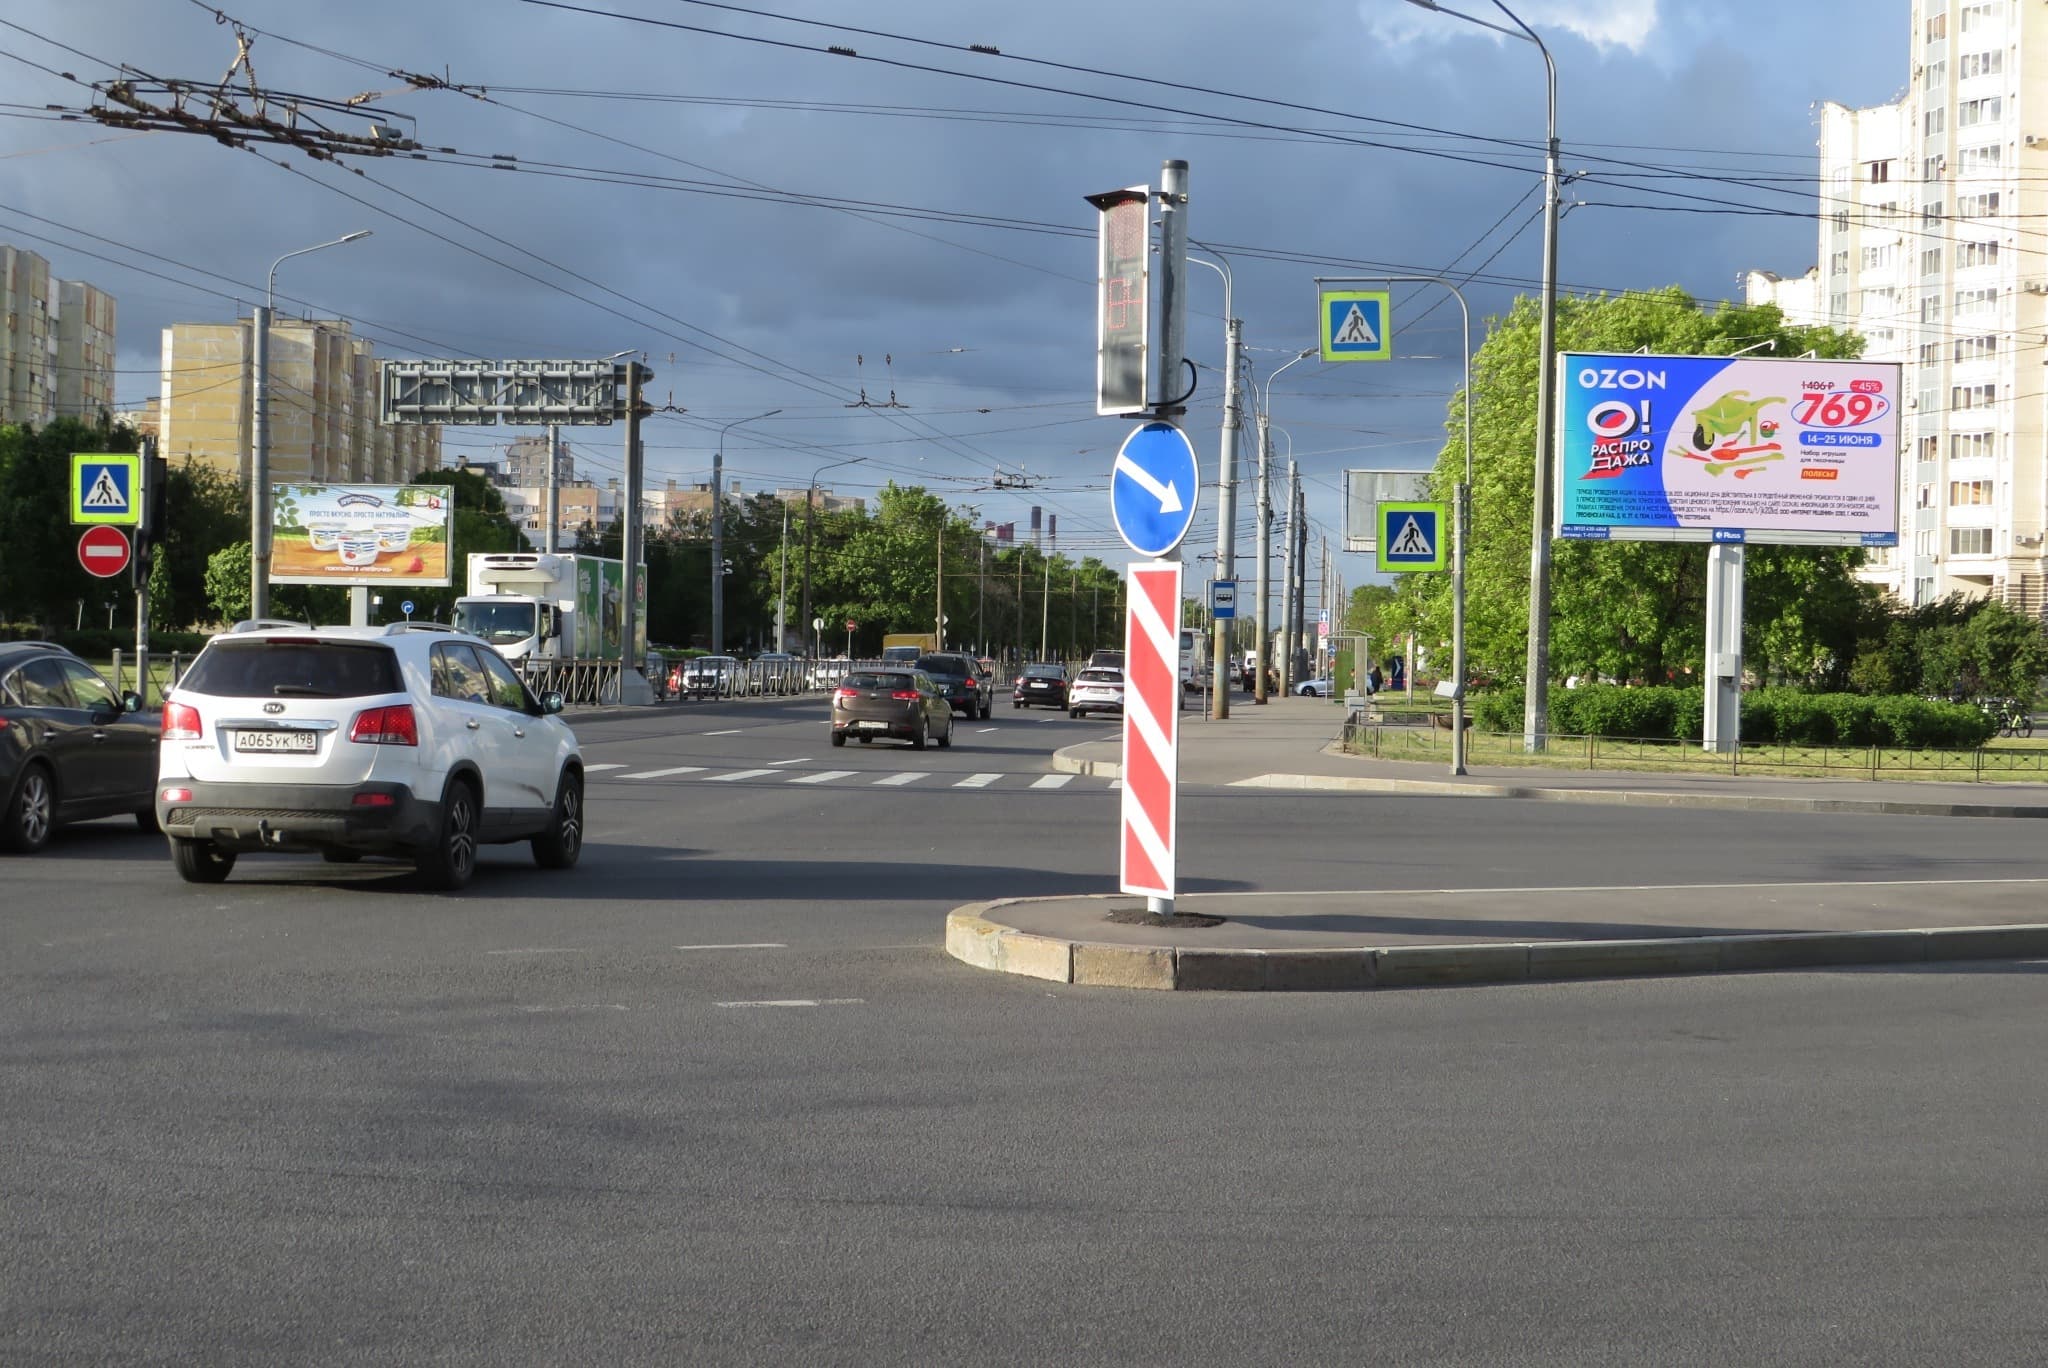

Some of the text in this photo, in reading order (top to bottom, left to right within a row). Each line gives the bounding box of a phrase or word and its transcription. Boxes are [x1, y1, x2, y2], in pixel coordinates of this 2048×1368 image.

[1579, 368, 1666, 390] OZON
[1800, 393, 1873, 426] 769
[1839, 434, 1873, 445] ИЮНЯ
[1591, 440, 1651, 456] РАСПРО
[1590, 453, 1651, 471] ДАЖА
[1803, 470, 1836, 478] ПОЛЕСЬЕ
[309, 510, 330, 518] ПРОСТО
[353, 511, 374, 519] ПРОСТО
[1723, 531, 1741, 540] Russ
[266, 703, 284, 714] KIA
[240, 733, 314, 748] А065УК 198
